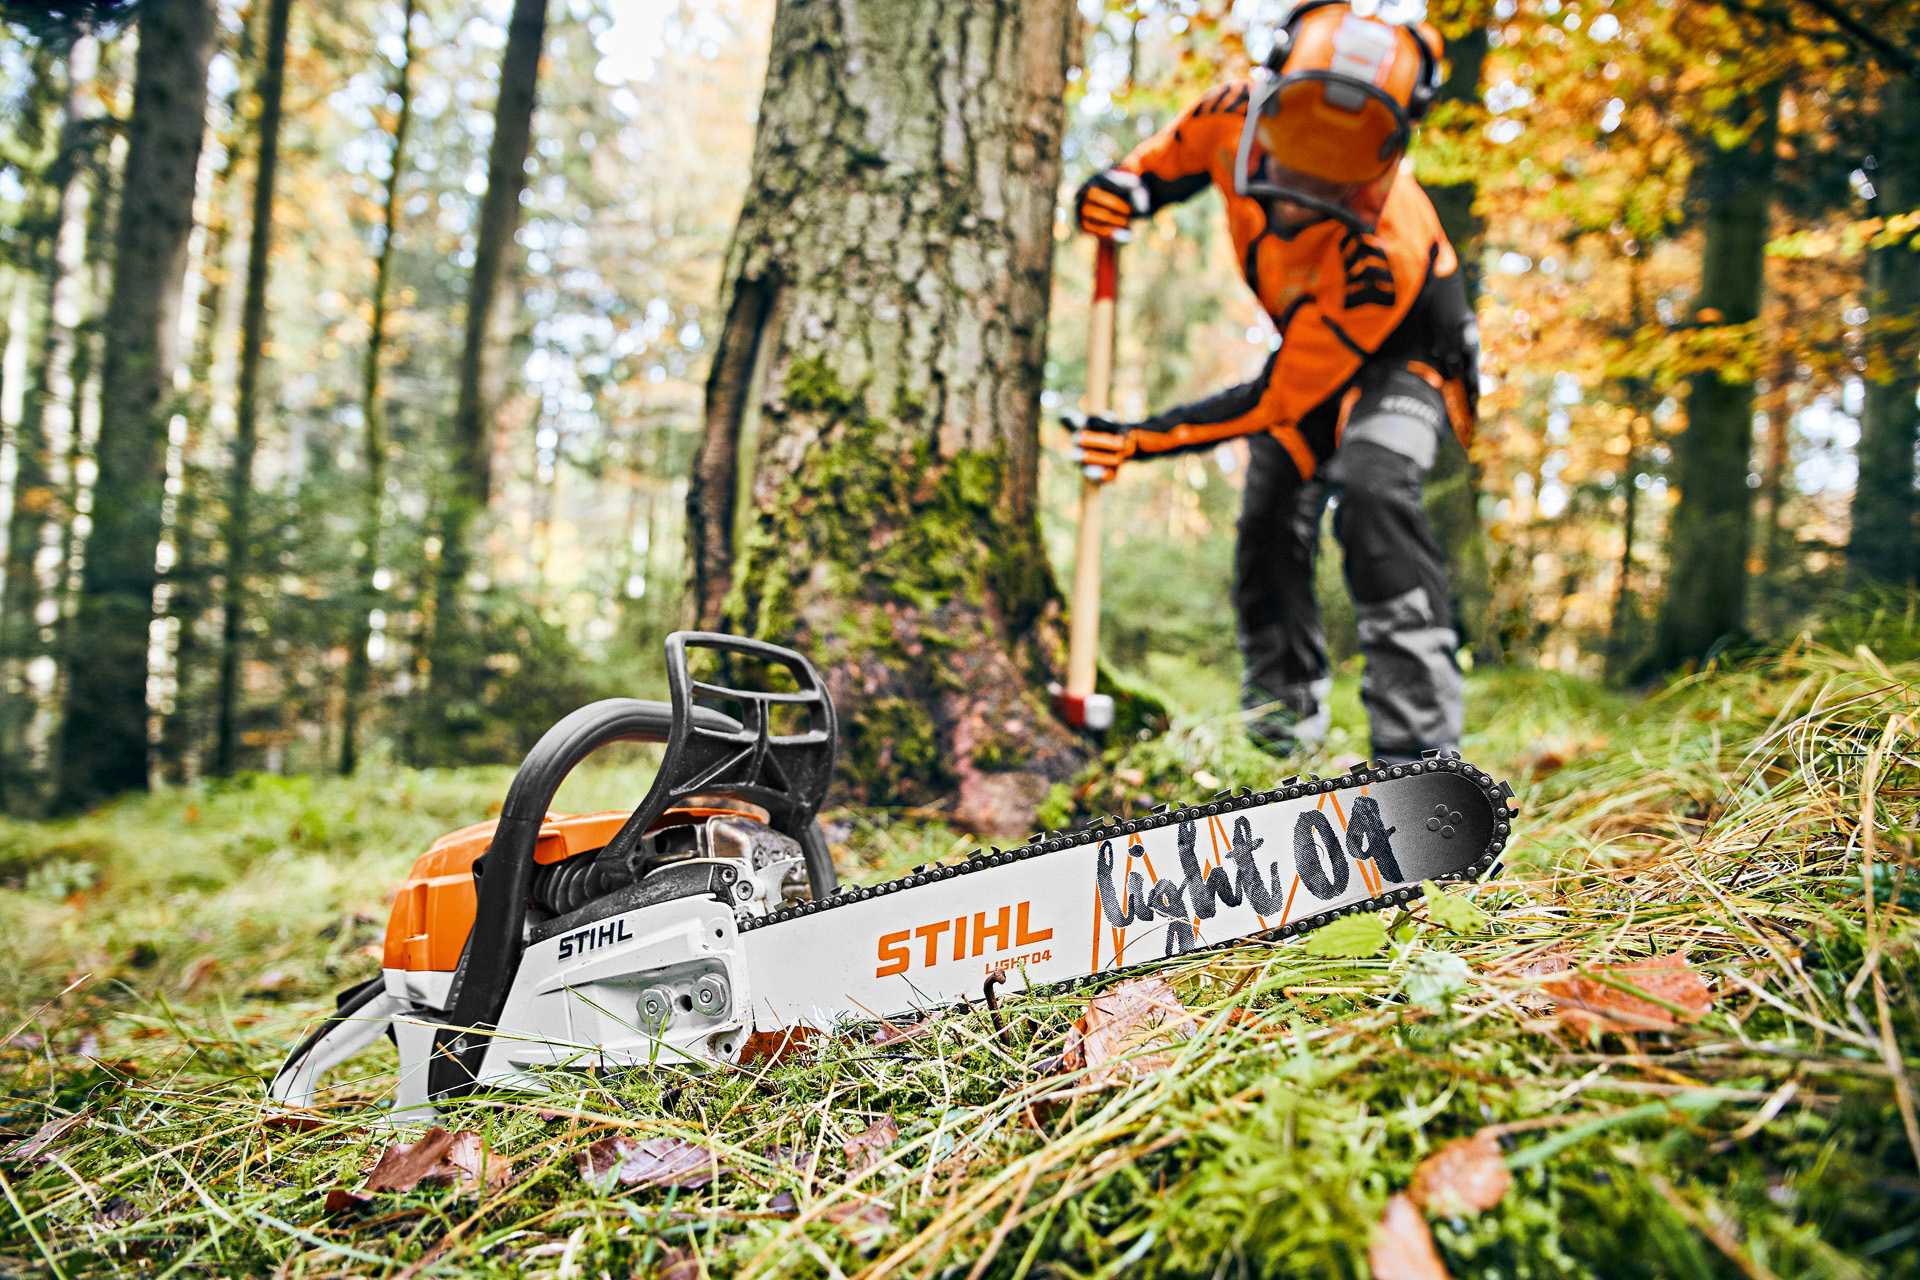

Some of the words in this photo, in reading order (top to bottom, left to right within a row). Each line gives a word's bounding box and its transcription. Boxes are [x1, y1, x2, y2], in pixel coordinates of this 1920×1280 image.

[1097, 816, 1283, 956] light
[558, 919, 633, 960] STIHL
[876, 900, 1053, 978] STIHL
